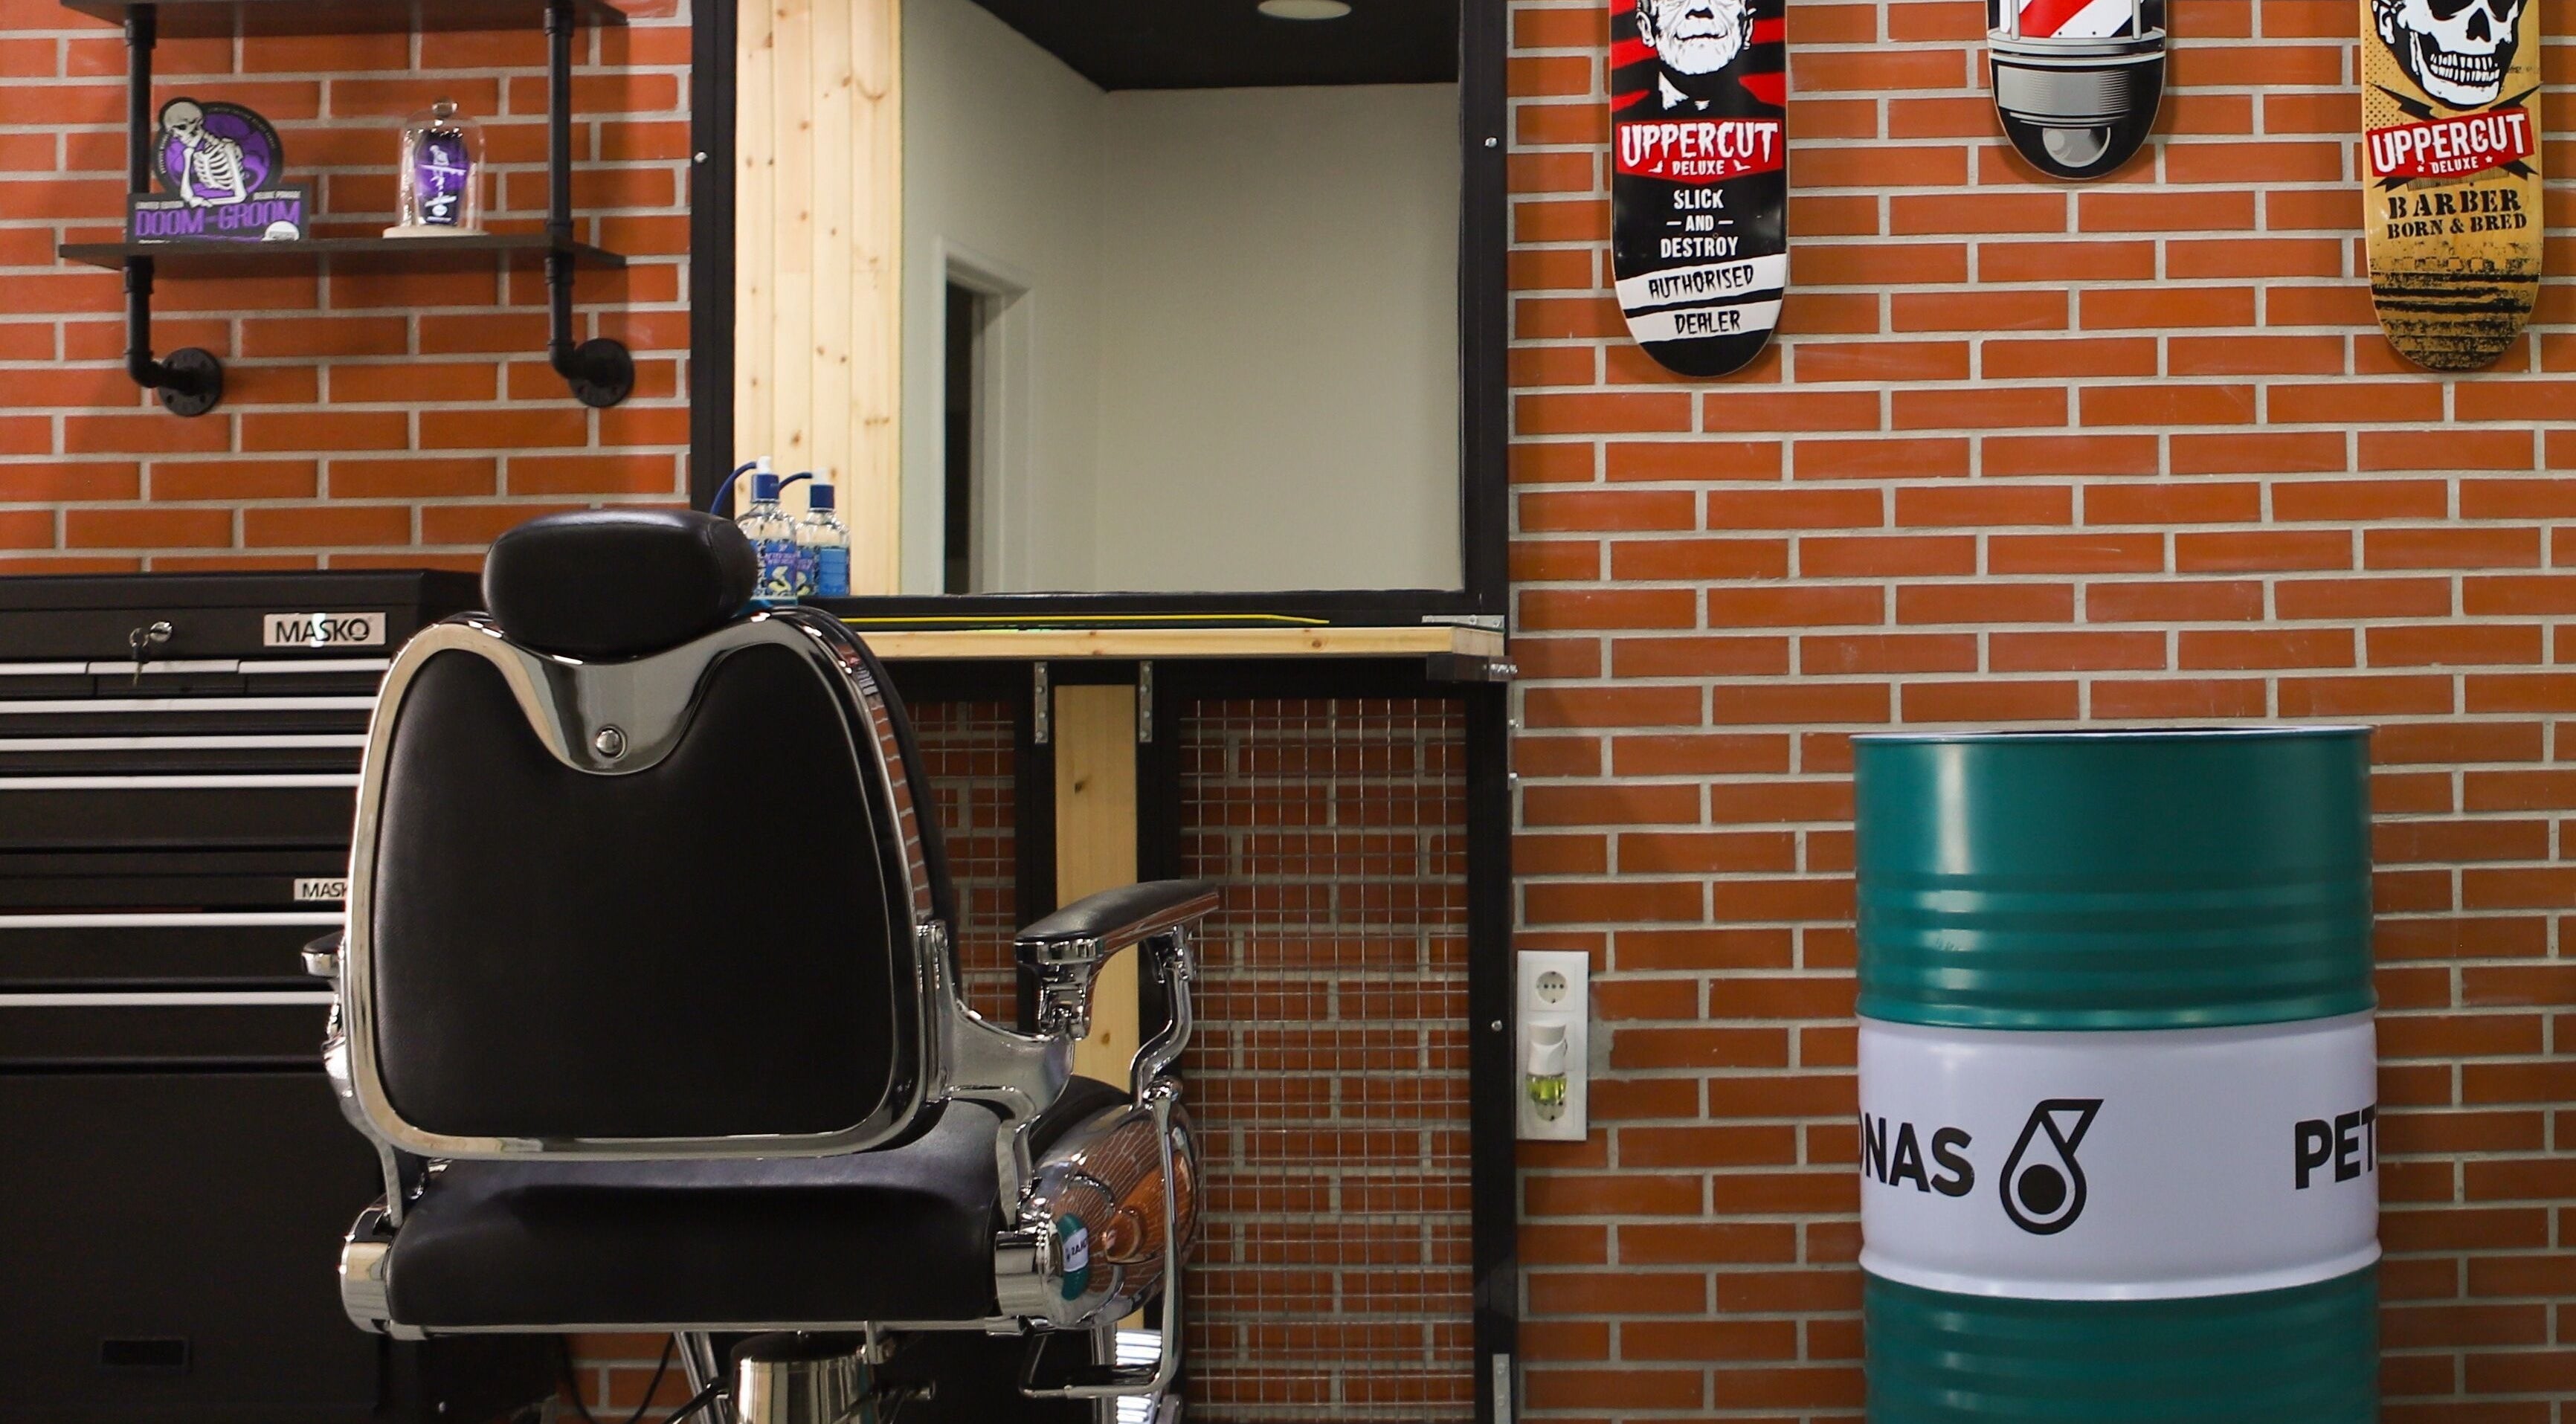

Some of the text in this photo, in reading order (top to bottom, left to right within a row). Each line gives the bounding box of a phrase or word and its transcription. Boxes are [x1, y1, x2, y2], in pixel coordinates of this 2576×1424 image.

[1621, 122, 1778, 167] UPPERCUT
[2371, 113, 2526, 173] UPPERCUT
[1672, 160, 1725, 175] DELUXE
[2430, 156, 2479, 174] DELUXE
[1673, 189, 1725, 209] SLICK
[2388, 189, 2522, 219] BARBER
[1685, 215, 1714, 232] AND
[2387, 213, 2527, 239] BORN & BRED
[1660, 236, 1739, 259] DESTROY
[1648, 264, 1754, 300] AUTHORISED
[1674, 309, 1741, 335] DEALER
[276, 618, 370, 642] MASKO
[1859, 1112, 1975, 1197] NAS
